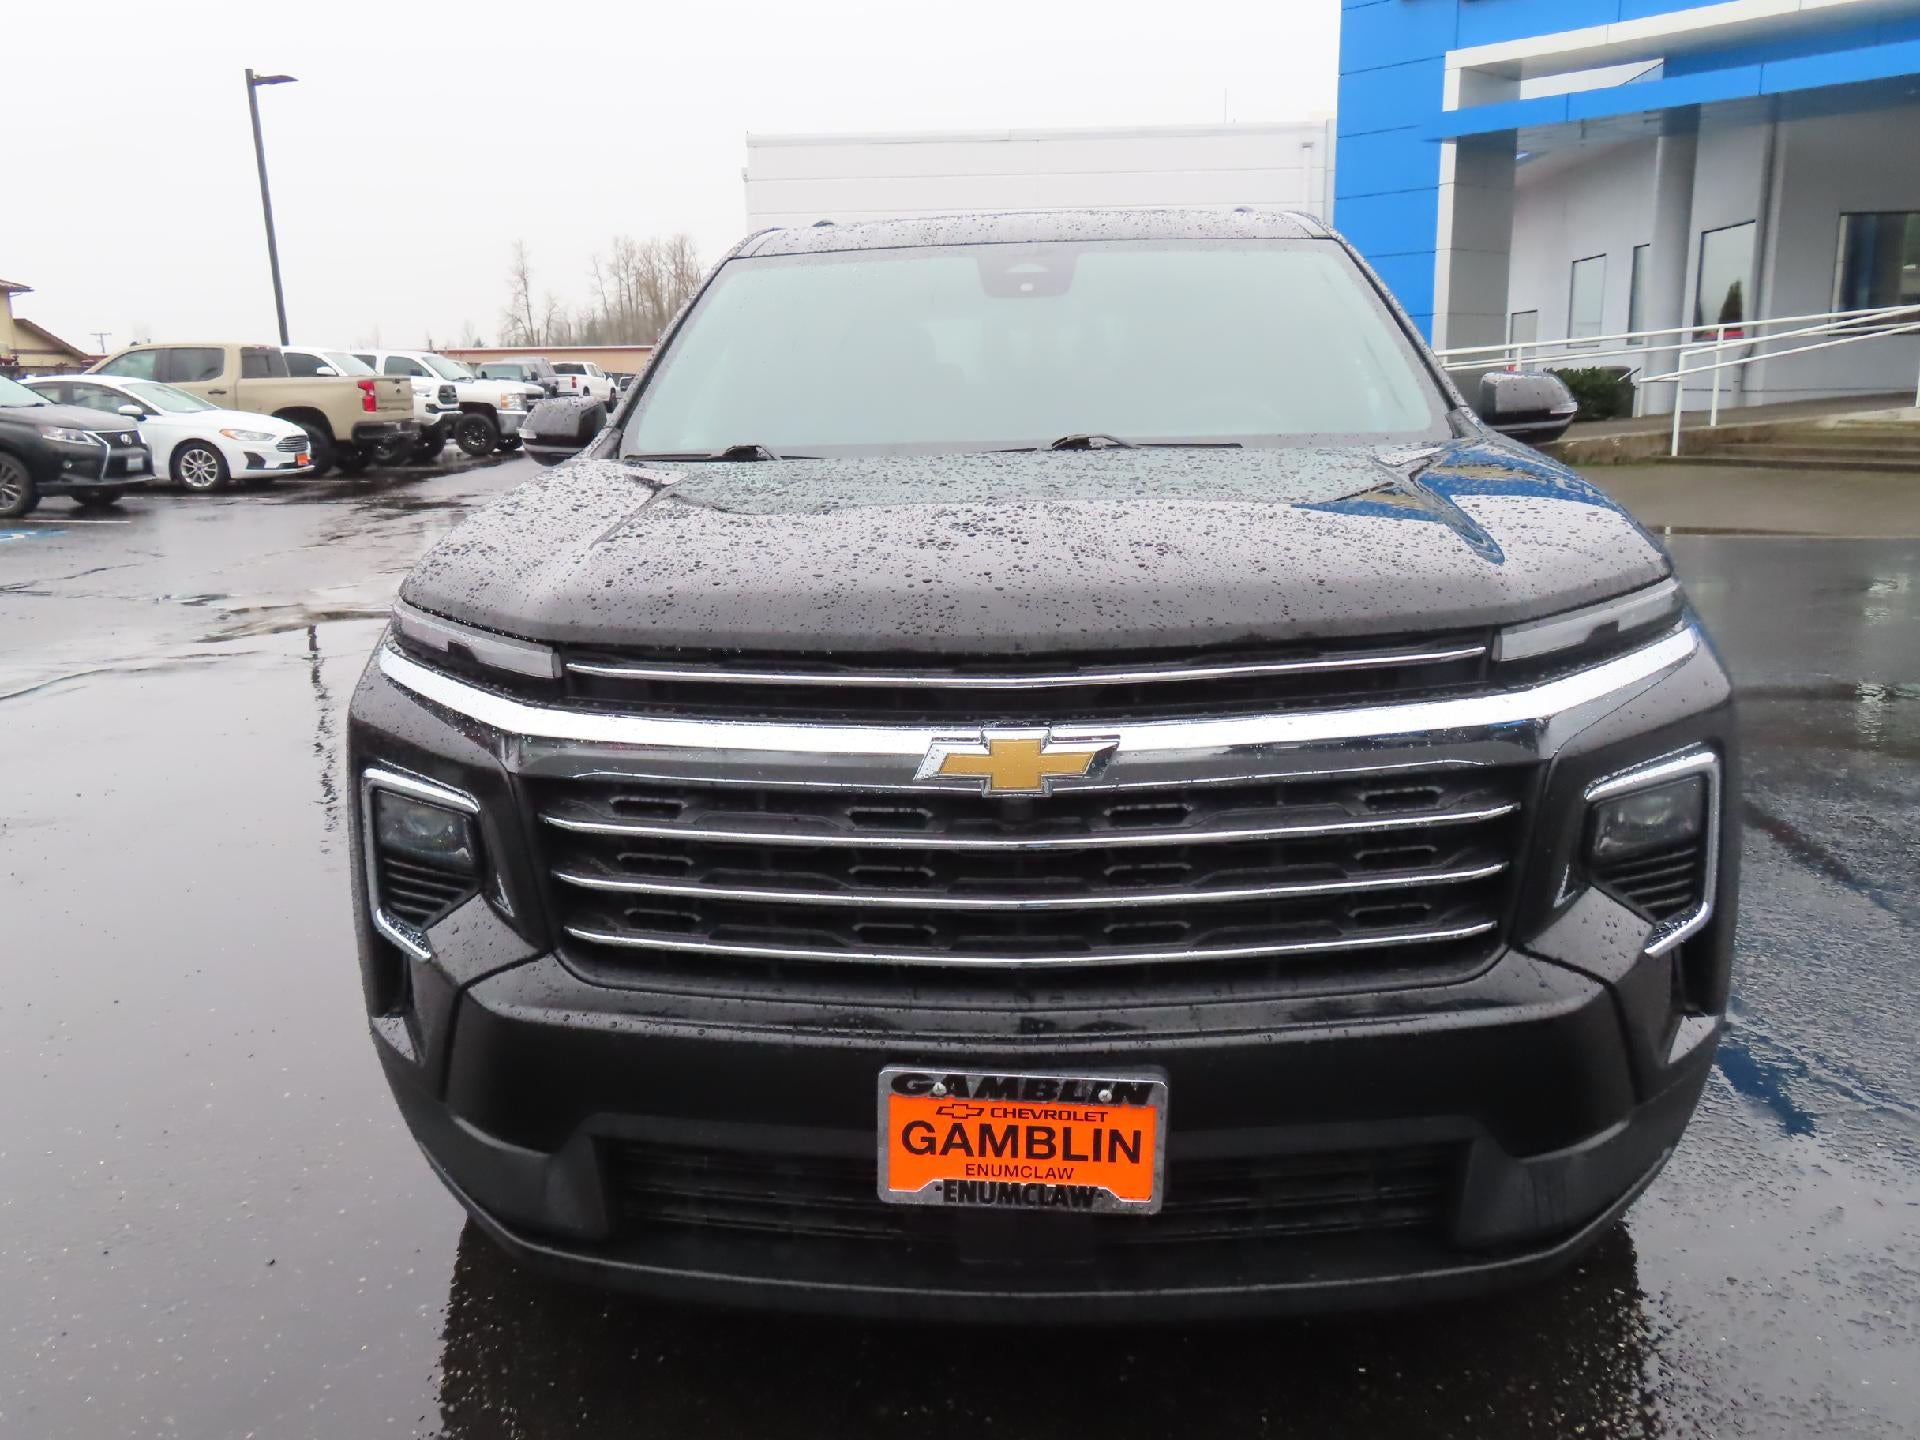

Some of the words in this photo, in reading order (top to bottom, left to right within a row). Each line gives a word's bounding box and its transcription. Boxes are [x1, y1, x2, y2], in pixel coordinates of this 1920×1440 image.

[891, 1073, 1154, 1105] GAMBLIN
[990, 1107, 1108, 1122] CHEVROLET
[901, 1120, 1142, 1164] GAMBLIN
[965, 1163, 1074, 1180] ENUMCLAW
[943, 1178, 1099, 1208] ENUMCLAW
